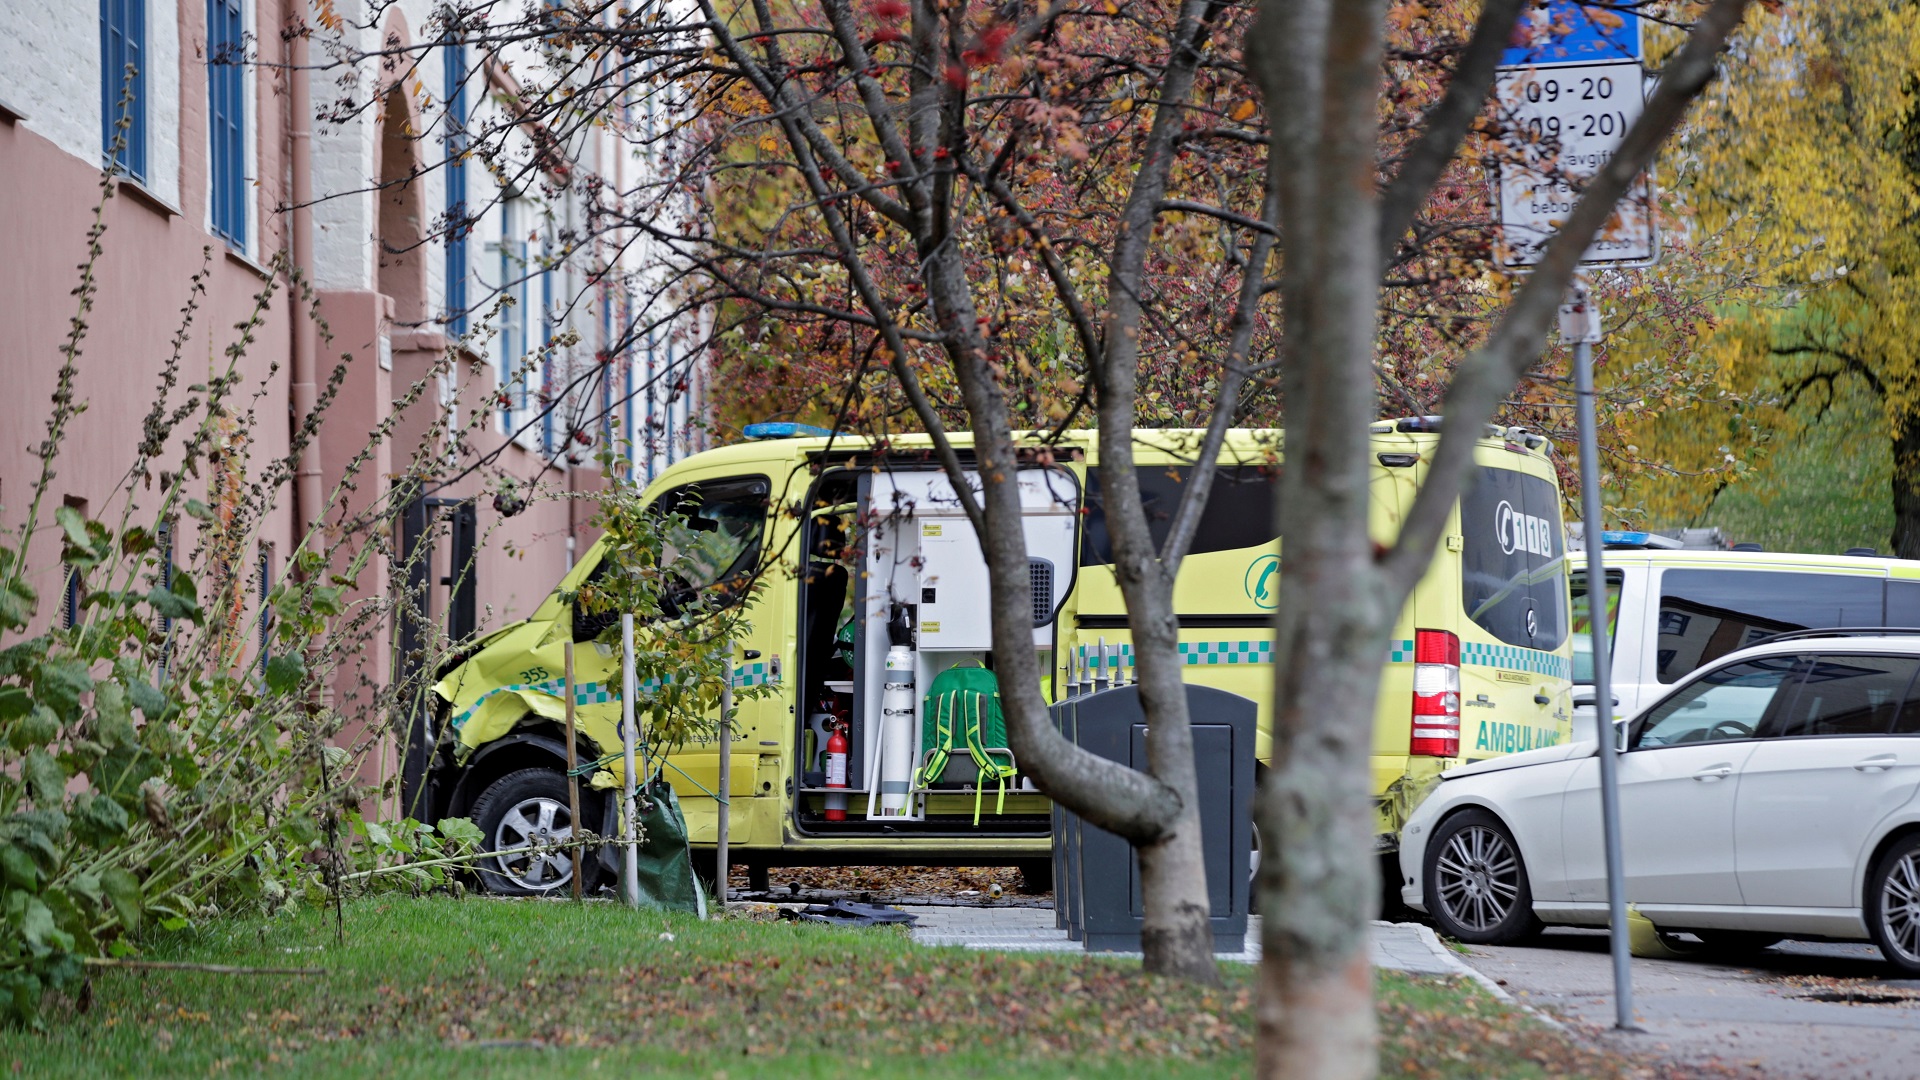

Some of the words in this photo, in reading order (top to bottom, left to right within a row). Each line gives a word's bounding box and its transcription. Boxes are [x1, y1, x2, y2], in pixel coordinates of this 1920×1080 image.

[1526, 76, 1613, 103] 09-20
[1531, 200, 1579, 214] beboe
[1516, 517, 1549, 553] 113
[519, 666, 549, 685] 355
